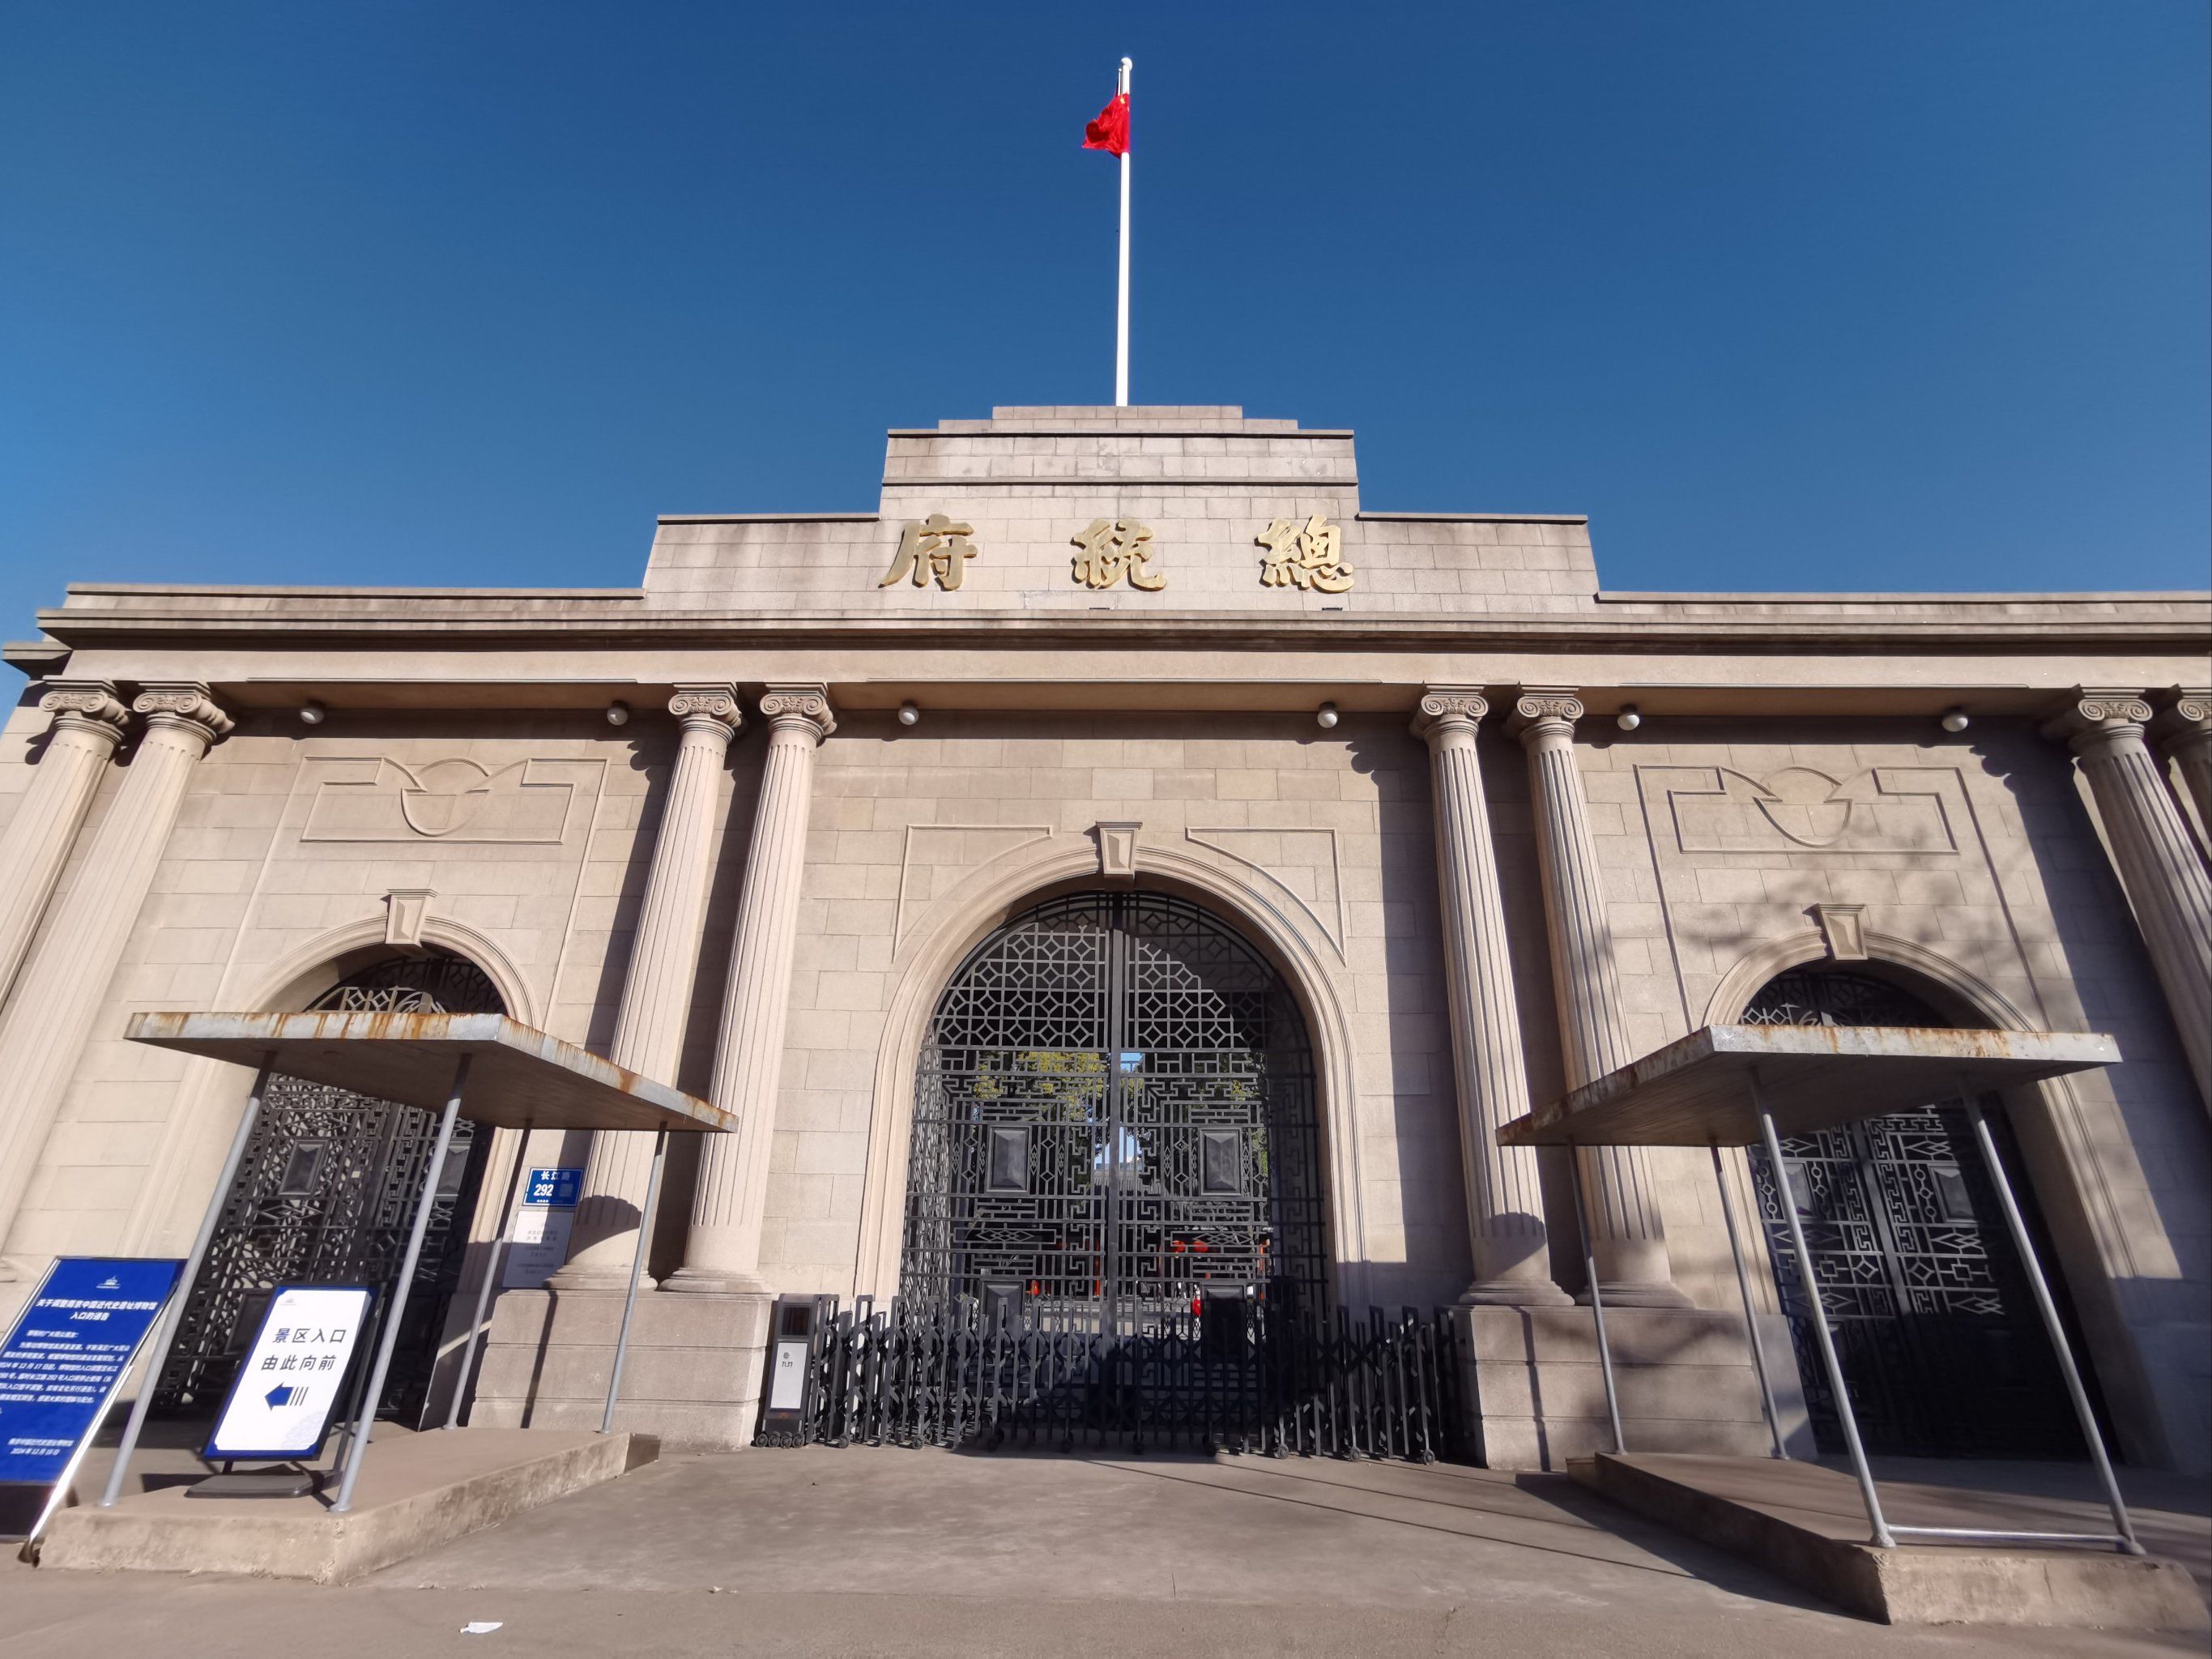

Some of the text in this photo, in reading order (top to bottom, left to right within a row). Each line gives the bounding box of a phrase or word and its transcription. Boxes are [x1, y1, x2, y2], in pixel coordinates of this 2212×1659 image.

[533, 1183, 554, 1196] 292
[272, 1328, 347, 1343] 景区入口
[261, 1354, 337, 1371] 由此向前
